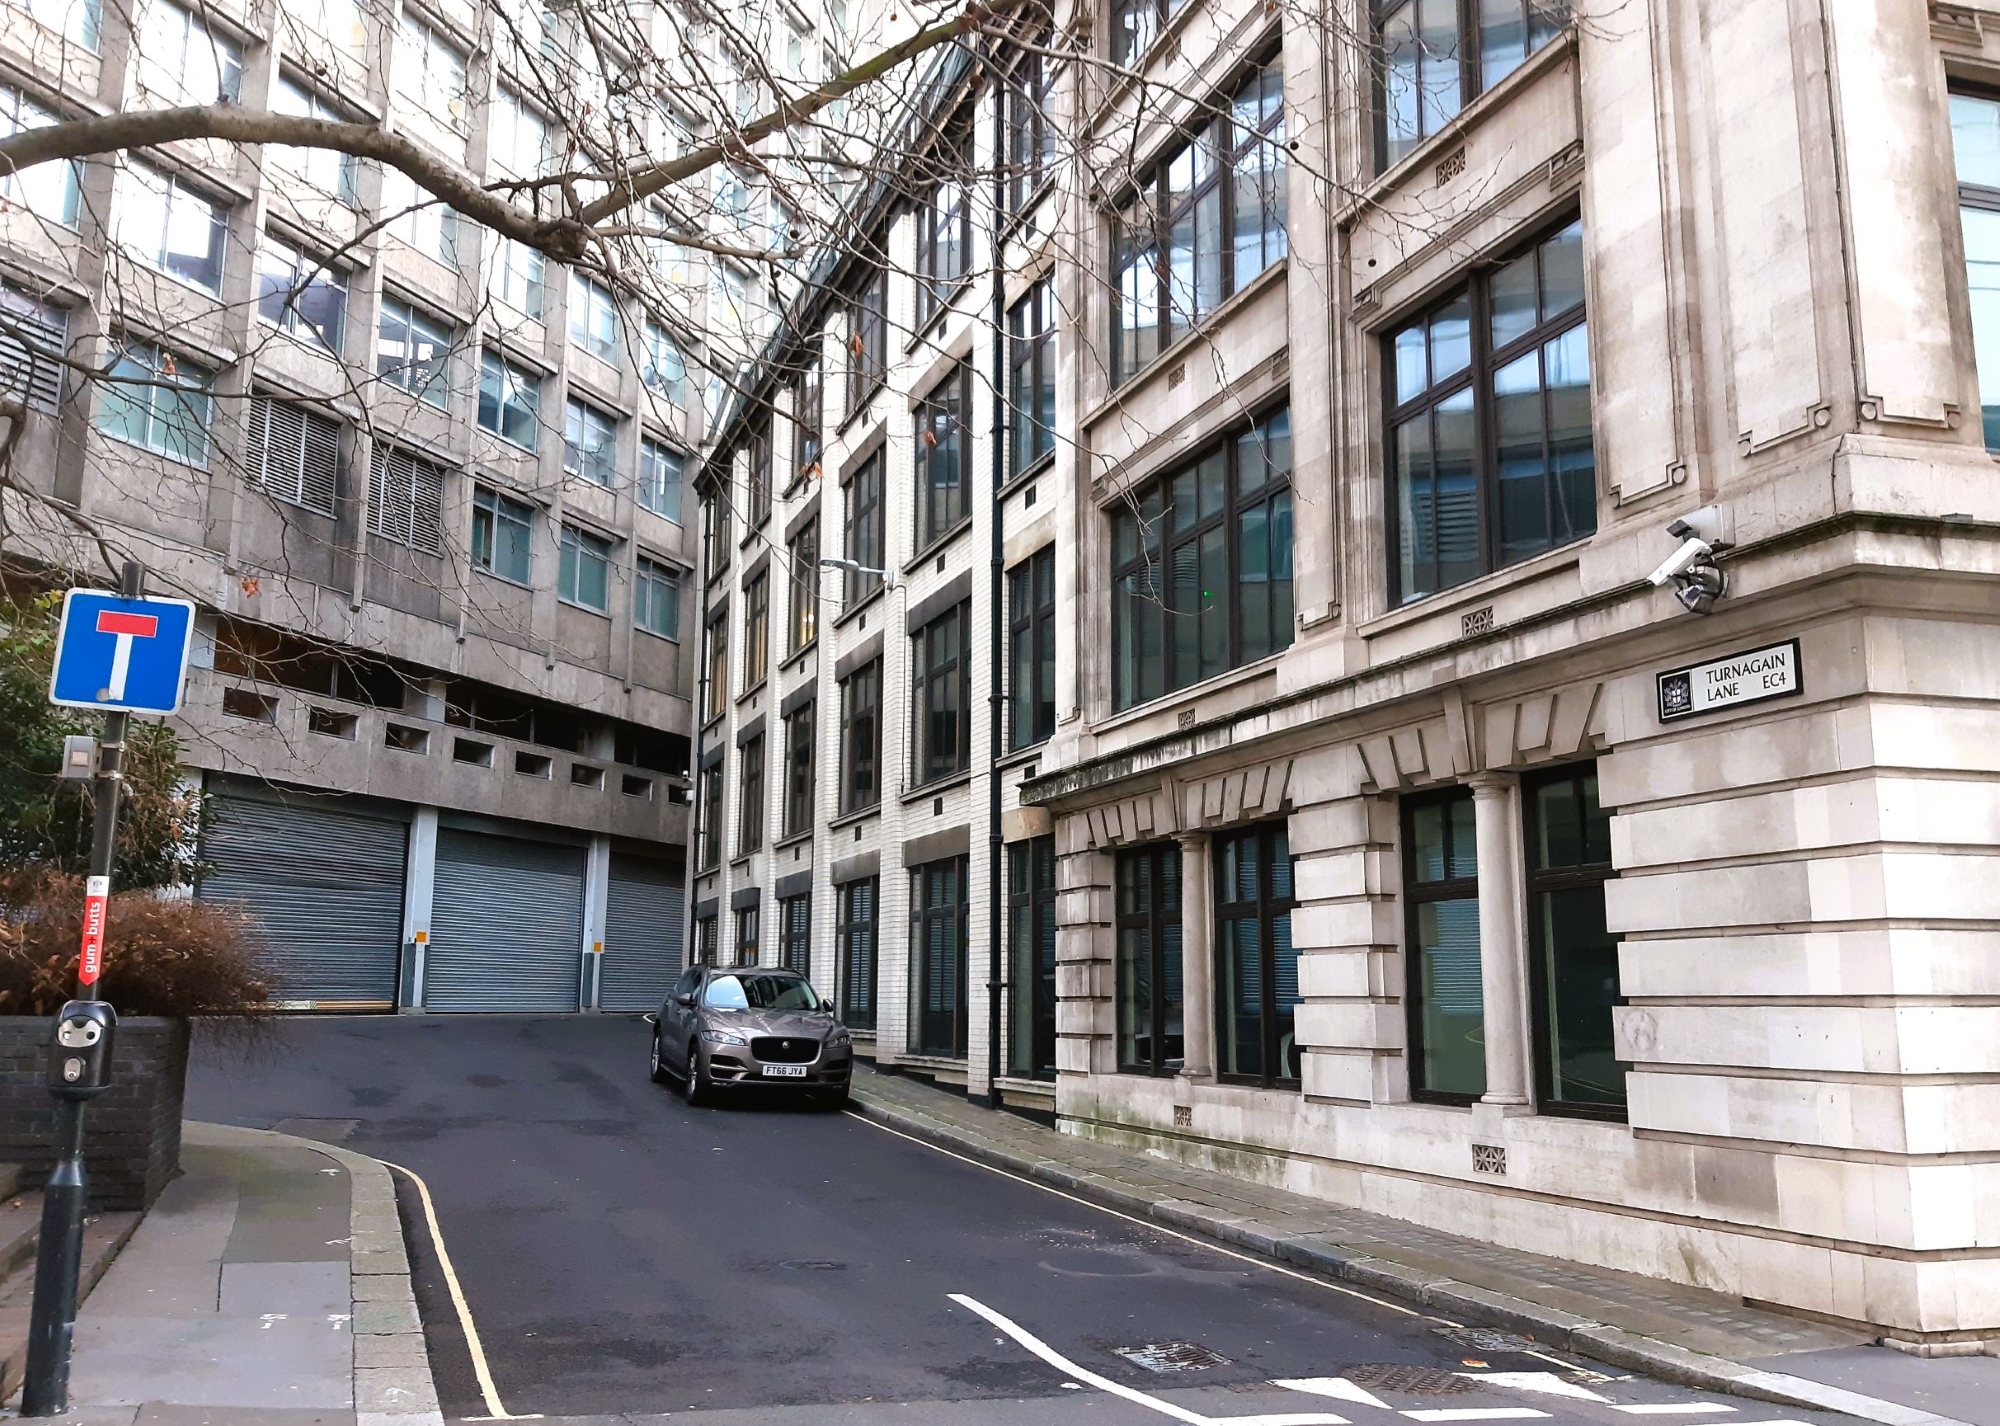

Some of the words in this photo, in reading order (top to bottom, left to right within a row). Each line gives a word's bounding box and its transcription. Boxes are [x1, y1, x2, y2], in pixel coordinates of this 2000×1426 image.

[1706, 653, 1785, 684] TURNAGAIN
[1708, 682, 1740, 702] LANE
[1762, 671, 1786, 690] EC4
[86, 902, 100, 936] butts
[85, 944, 96, 973] gum
[766, 1066, 786, 1075] FT66
